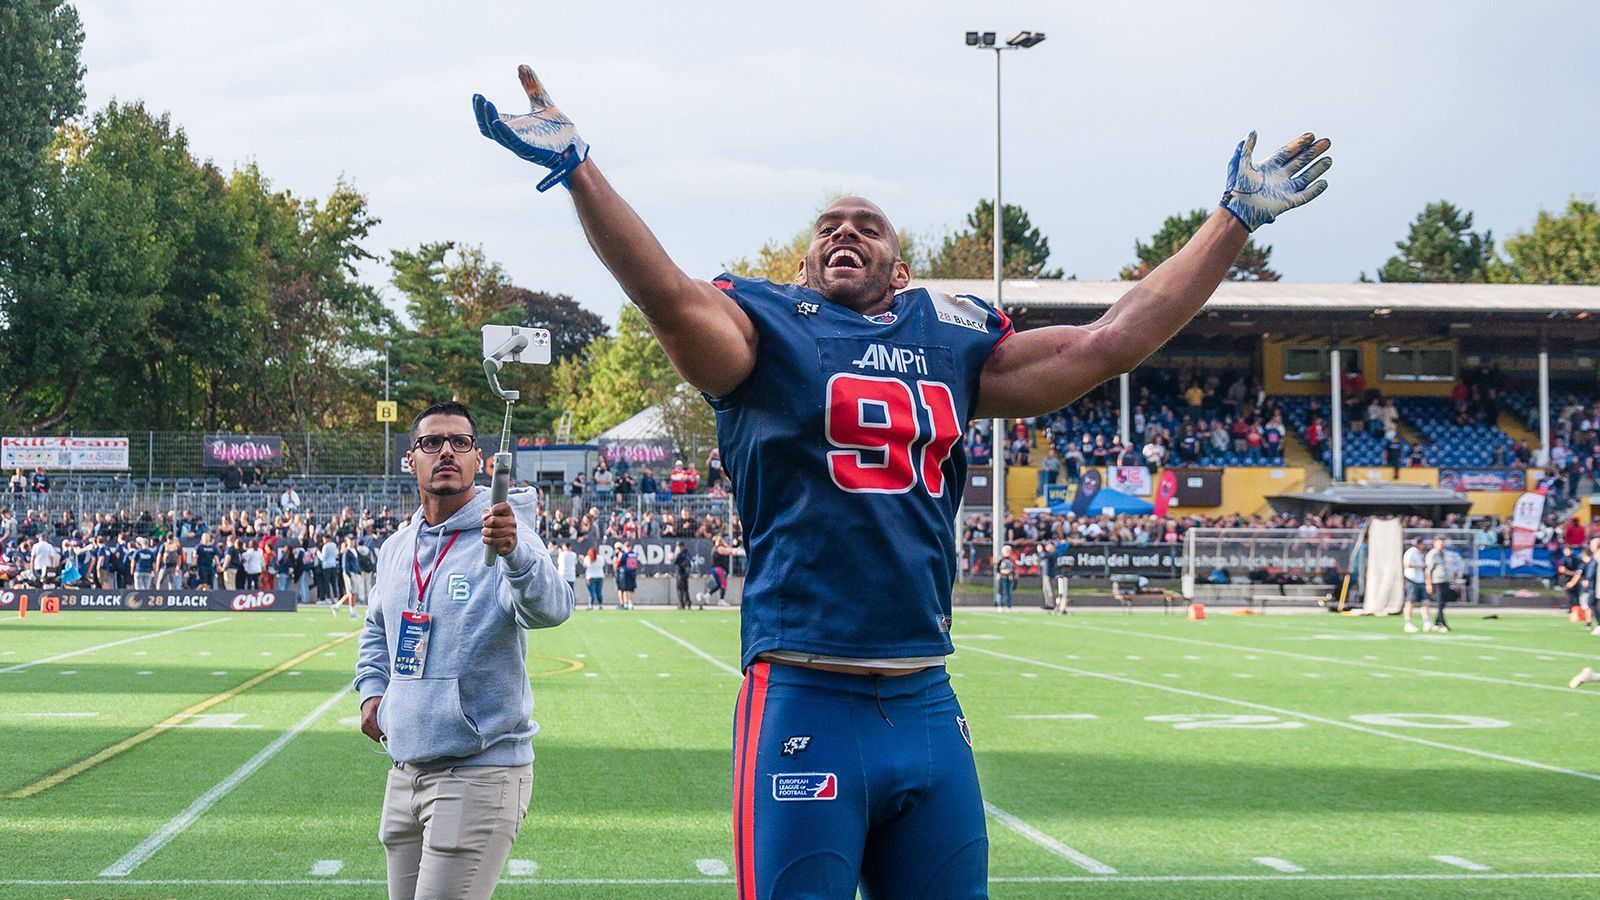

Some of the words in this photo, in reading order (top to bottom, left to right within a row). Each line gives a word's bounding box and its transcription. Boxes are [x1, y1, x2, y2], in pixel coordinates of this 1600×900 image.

[938, 310, 952, 321] 28
[953, 315, 986, 332] BLACK
[852, 343, 928, 375] AMPri
[382, 407, 391, 418] B
[825, 372, 962, 498] 91
[1132, 553, 1159, 567] und
[46, 600, 54, 611] G
[61, 595, 77, 606] 28
[81, 595, 121, 606] BLACK
[148, 595, 163, 606] 28
[167, 595, 208, 607] BLACK
[233, 592, 275, 610] Chio
